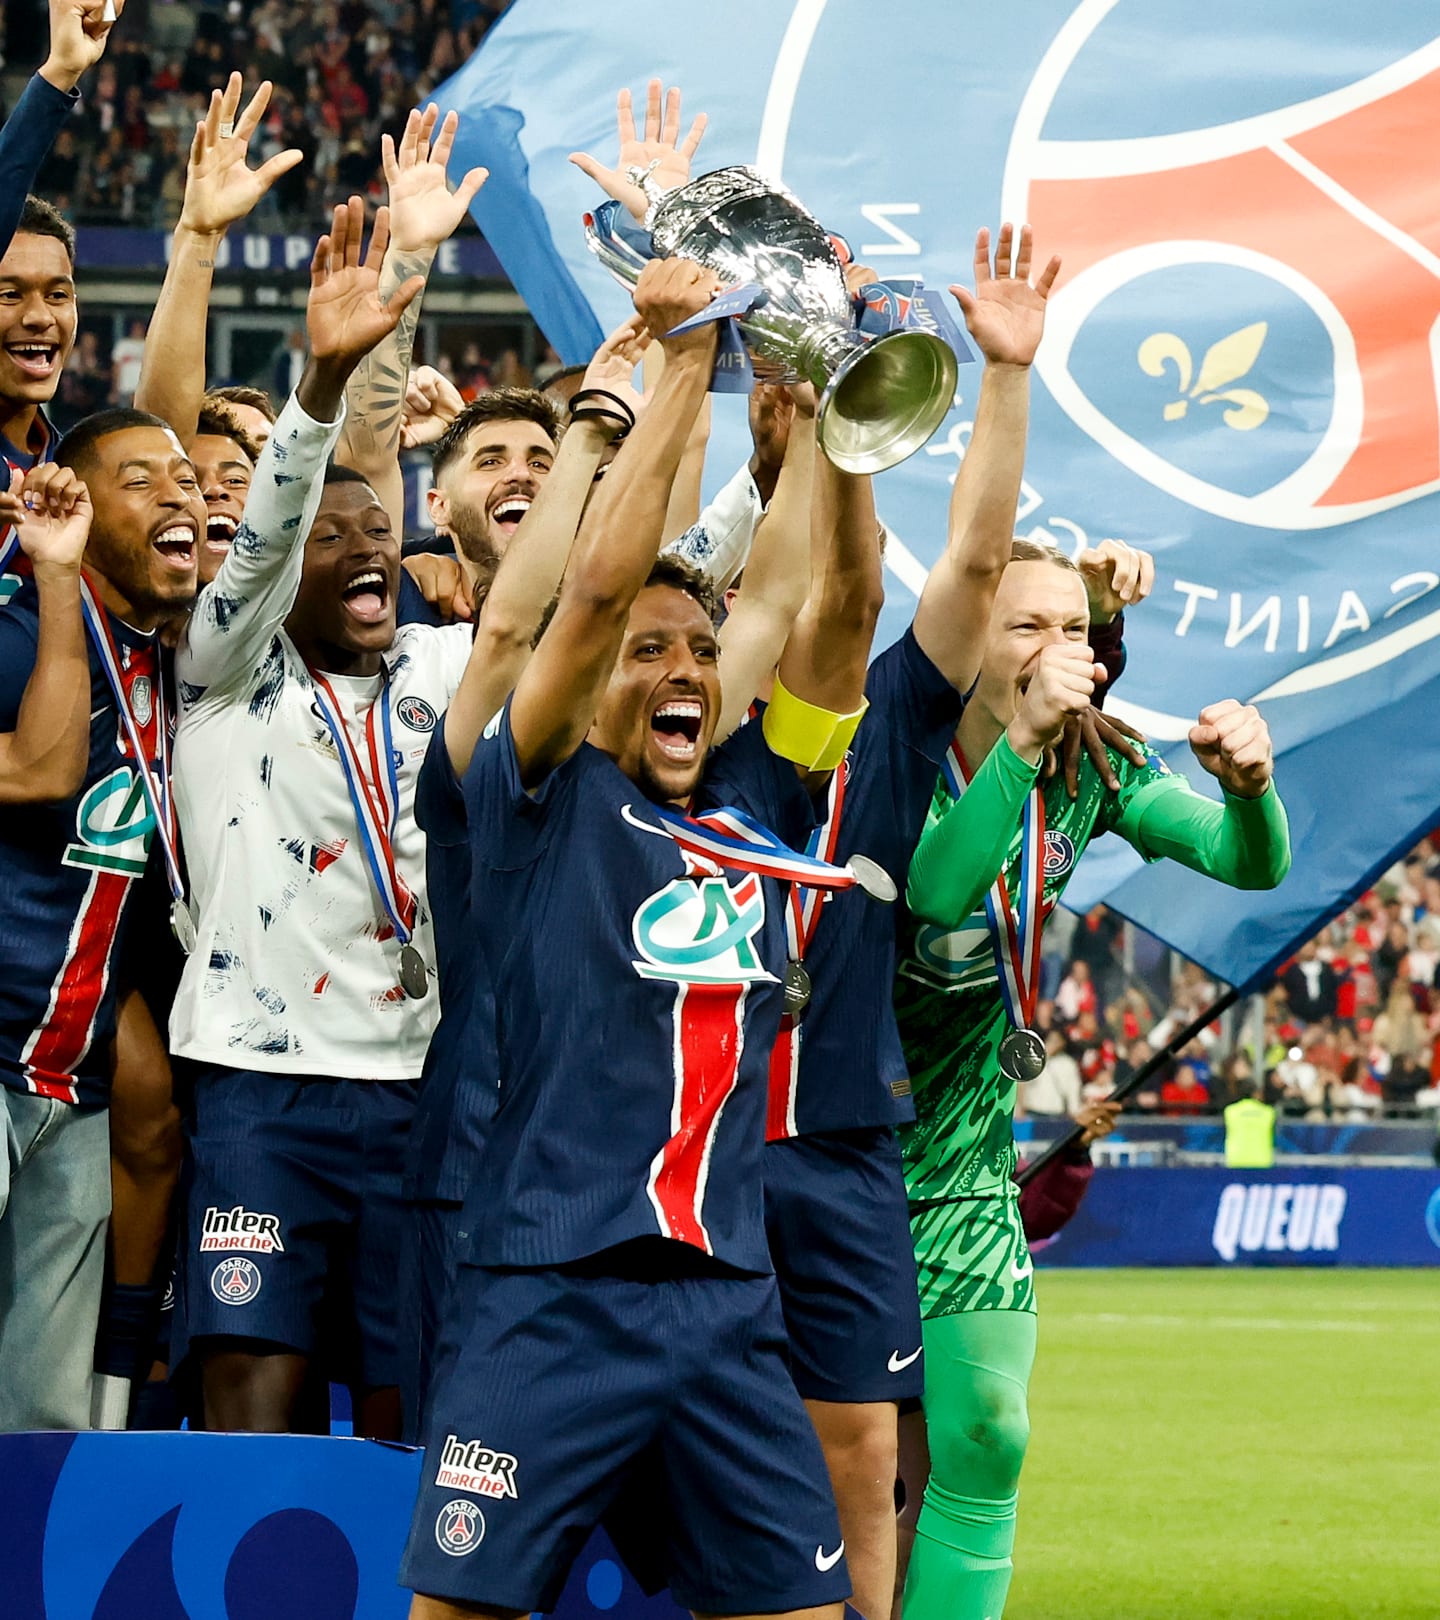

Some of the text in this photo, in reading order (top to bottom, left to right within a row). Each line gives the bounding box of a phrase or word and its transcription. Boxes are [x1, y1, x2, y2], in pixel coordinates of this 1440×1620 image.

[1212, 1183, 1347, 1262] QUEUR
[220, 1259, 253, 1273] PARIS
[446, 1502, 479, 1518] PARIS
